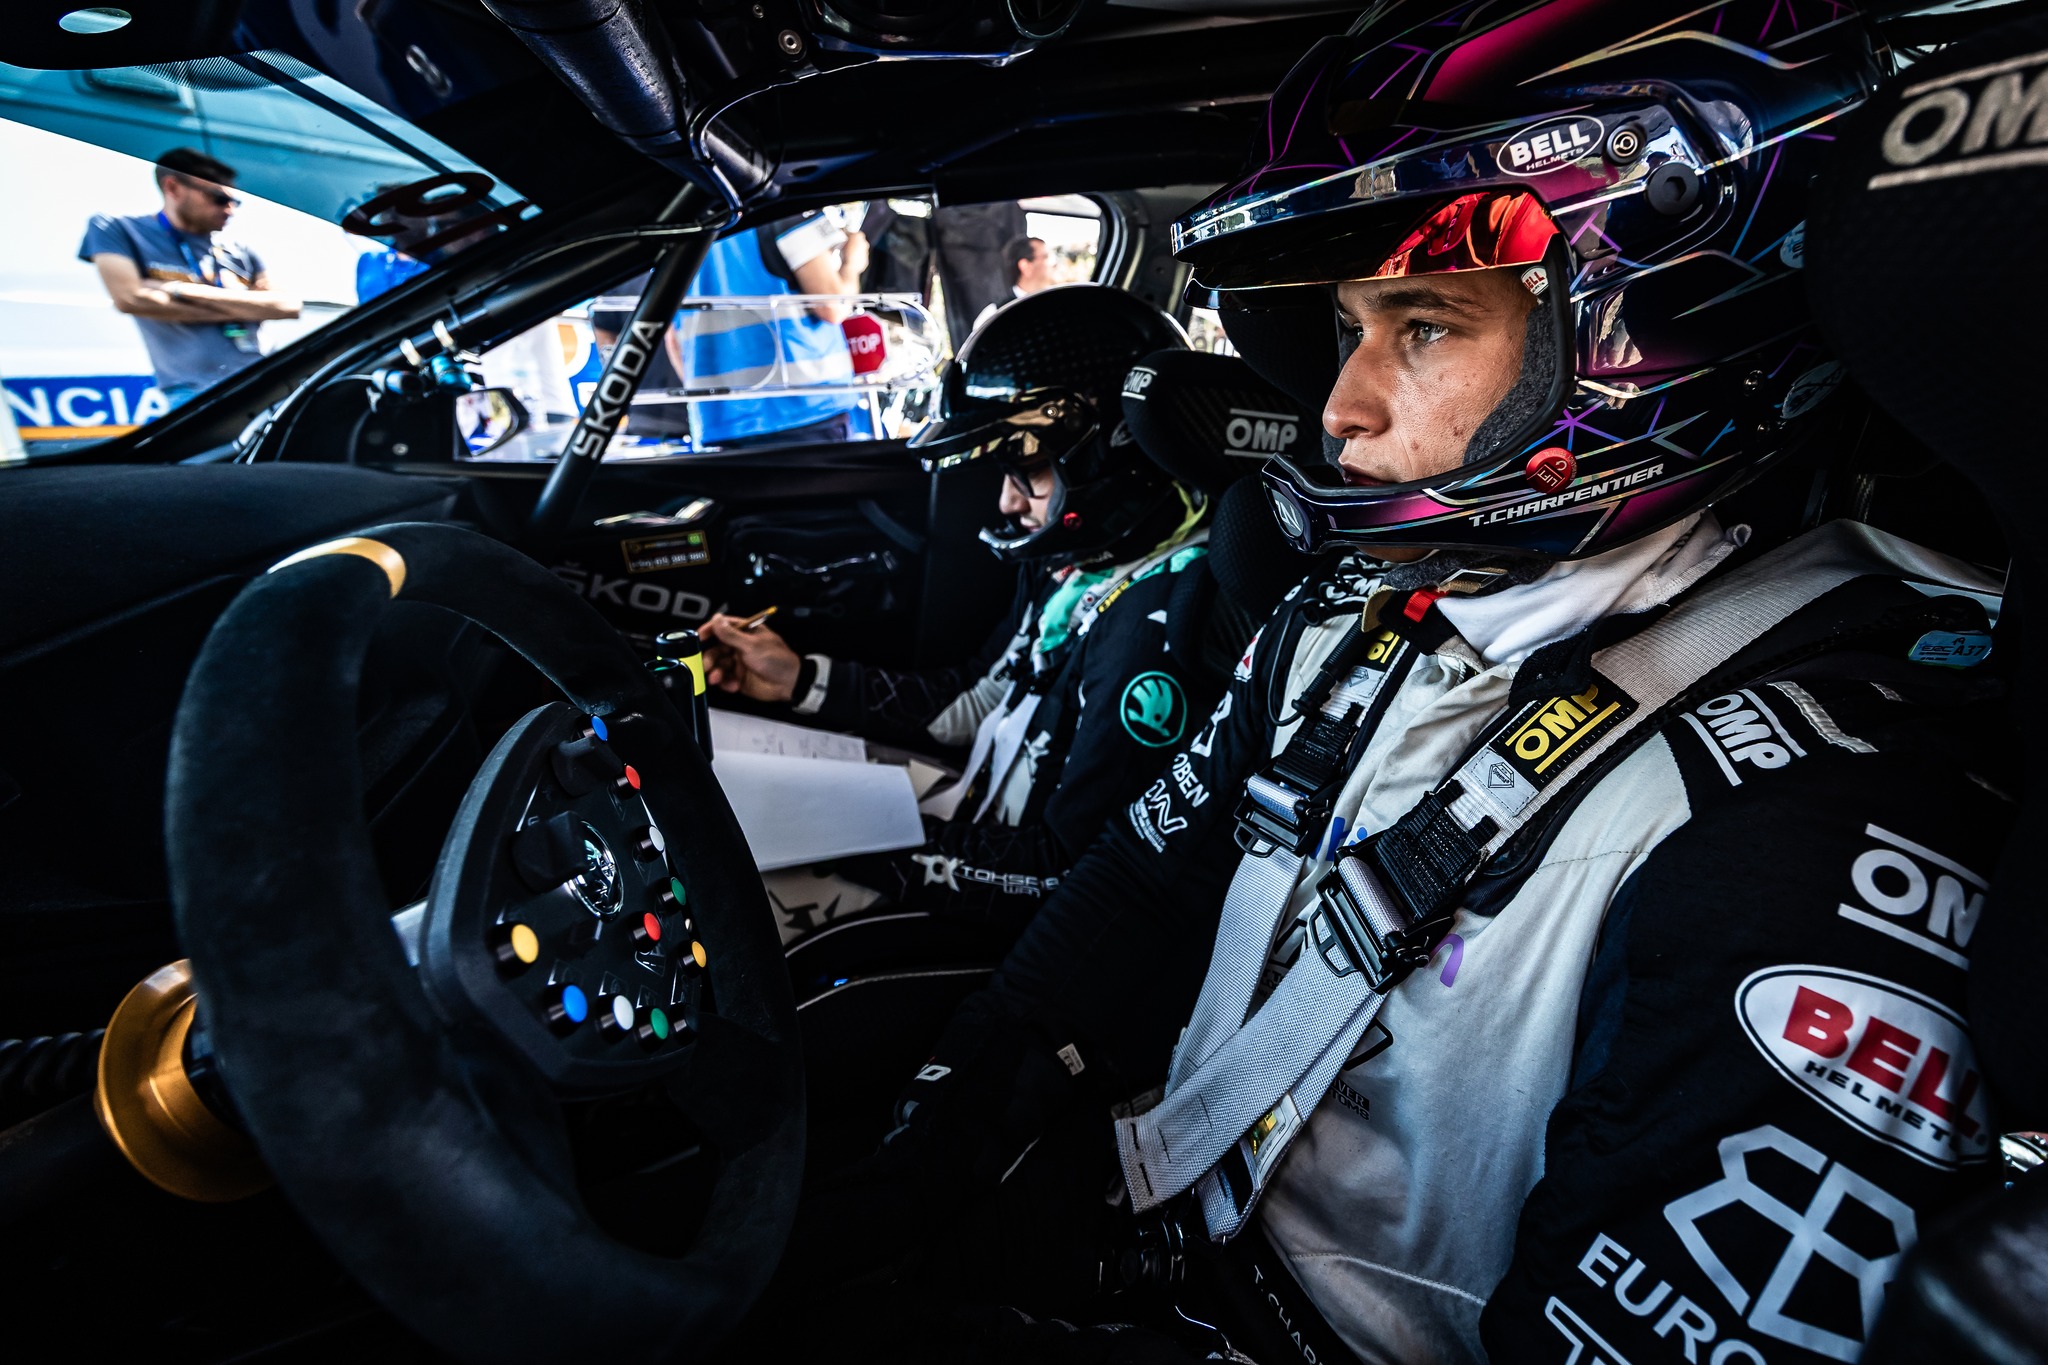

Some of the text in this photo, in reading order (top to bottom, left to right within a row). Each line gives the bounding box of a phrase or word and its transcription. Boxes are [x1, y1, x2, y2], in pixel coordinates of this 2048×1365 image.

[1509, 123, 1590, 168] BELL
[1526, 147, 1584, 171] HELMETS
[848, 333, 881, 356] TOP
[1226, 417, 1298, 451] OMP
[1469, 463, 1664, 527] T.CHARPENTIER
[1537, 470, 1558, 487] LIFT
[1952, 645, 1987, 657] A37
[1515, 684, 1599, 760] OMP
[1696, 694, 1791, 769] OMP
[1783, 985, 1981, 1138] BELL
